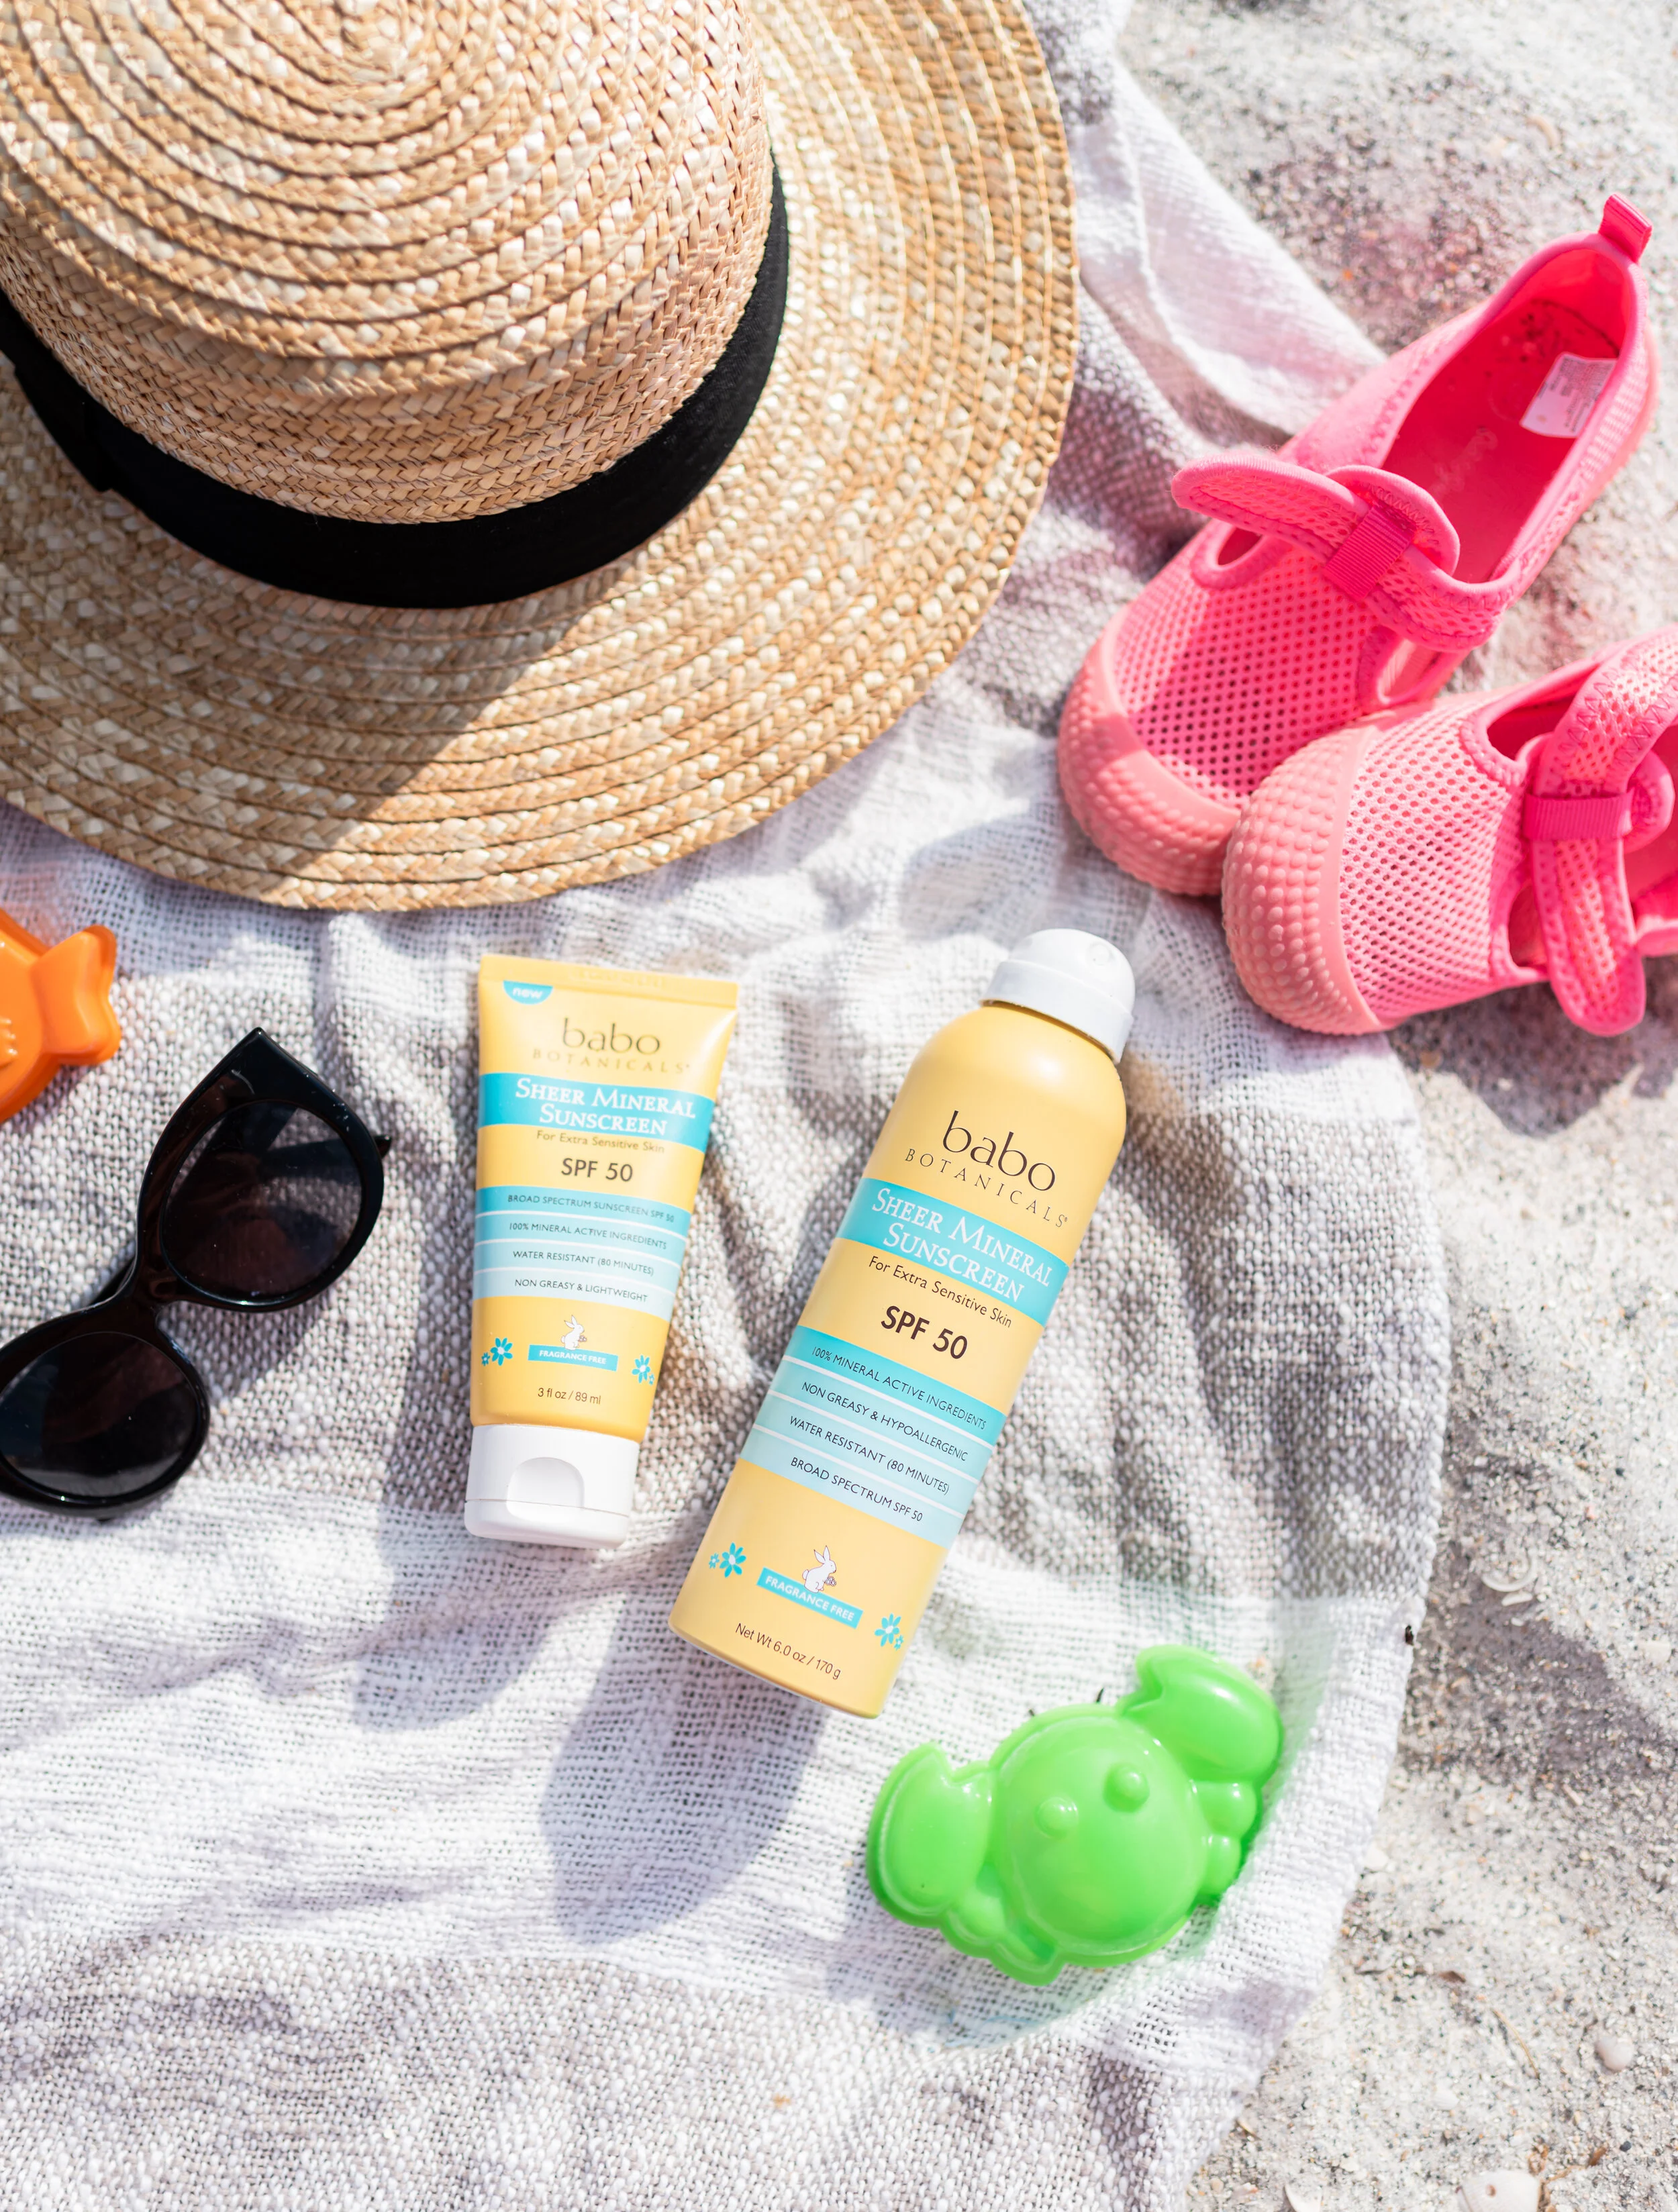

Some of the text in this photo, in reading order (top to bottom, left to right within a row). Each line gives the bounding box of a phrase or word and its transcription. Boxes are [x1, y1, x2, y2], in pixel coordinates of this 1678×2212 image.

[513, 987, 543, 999] new
[562, 1017, 660, 1054] babo
[515, 1078, 695, 1119] SHEER MINERAL
[540, 1103, 667, 1136] SUNSCREEN
[537, 1130, 664, 1152] For Extra Sensitive Skin
[942, 1110, 1055, 1191] babo
[561, 1158, 633, 1181] SPF 50
[508, 1195, 674, 1223] BROAD SPECTRUM SUNSCREEN SPF 50
[532, 1224, 571, 1234] MINERAL
[575, 1227, 607, 1238] ACTIVE
[609, 1231, 667, 1250] INGREDIENTS
[873, 1188, 1052, 1287] SHEER MINERAL
[547, 1253, 595, 1264] RESISTANT
[598, 1257, 611, 1266] (80
[613, 1260, 654, 1276] MINUTES)
[883, 1223, 1024, 1302] SUNSCREEN
[540, 1280, 575, 1290] GREASY
[585, 1285, 648, 1302] LIGHTWEIGHT
[869, 1256, 1012, 1327] For Extra Sensitive Skin
[881, 1306, 967, 1359] SPF 50
[539, 1350, 606, 1364] FRAGRANCE FREE
[538, 1388, 601, 1404] 3 fl oz / 89 ml
[812, 1346, 986, 1429] 100% MINERAL ACTIVE INGREDIENTS
[802, 1382, 968, 1461] NON GREASY & HYPOALLERGENIC
[790, 1416, 950, 1495] WATER RESISTANT (80 MINUTES)
[791, 1457, 923, 1521] BROAD SPECTRUM SPF 50
[765, 1576, 854, 1621] FRAGRANCE FREE
[736, 1623, 841, 1680] Net Wt 6.0 oz / 170 g
